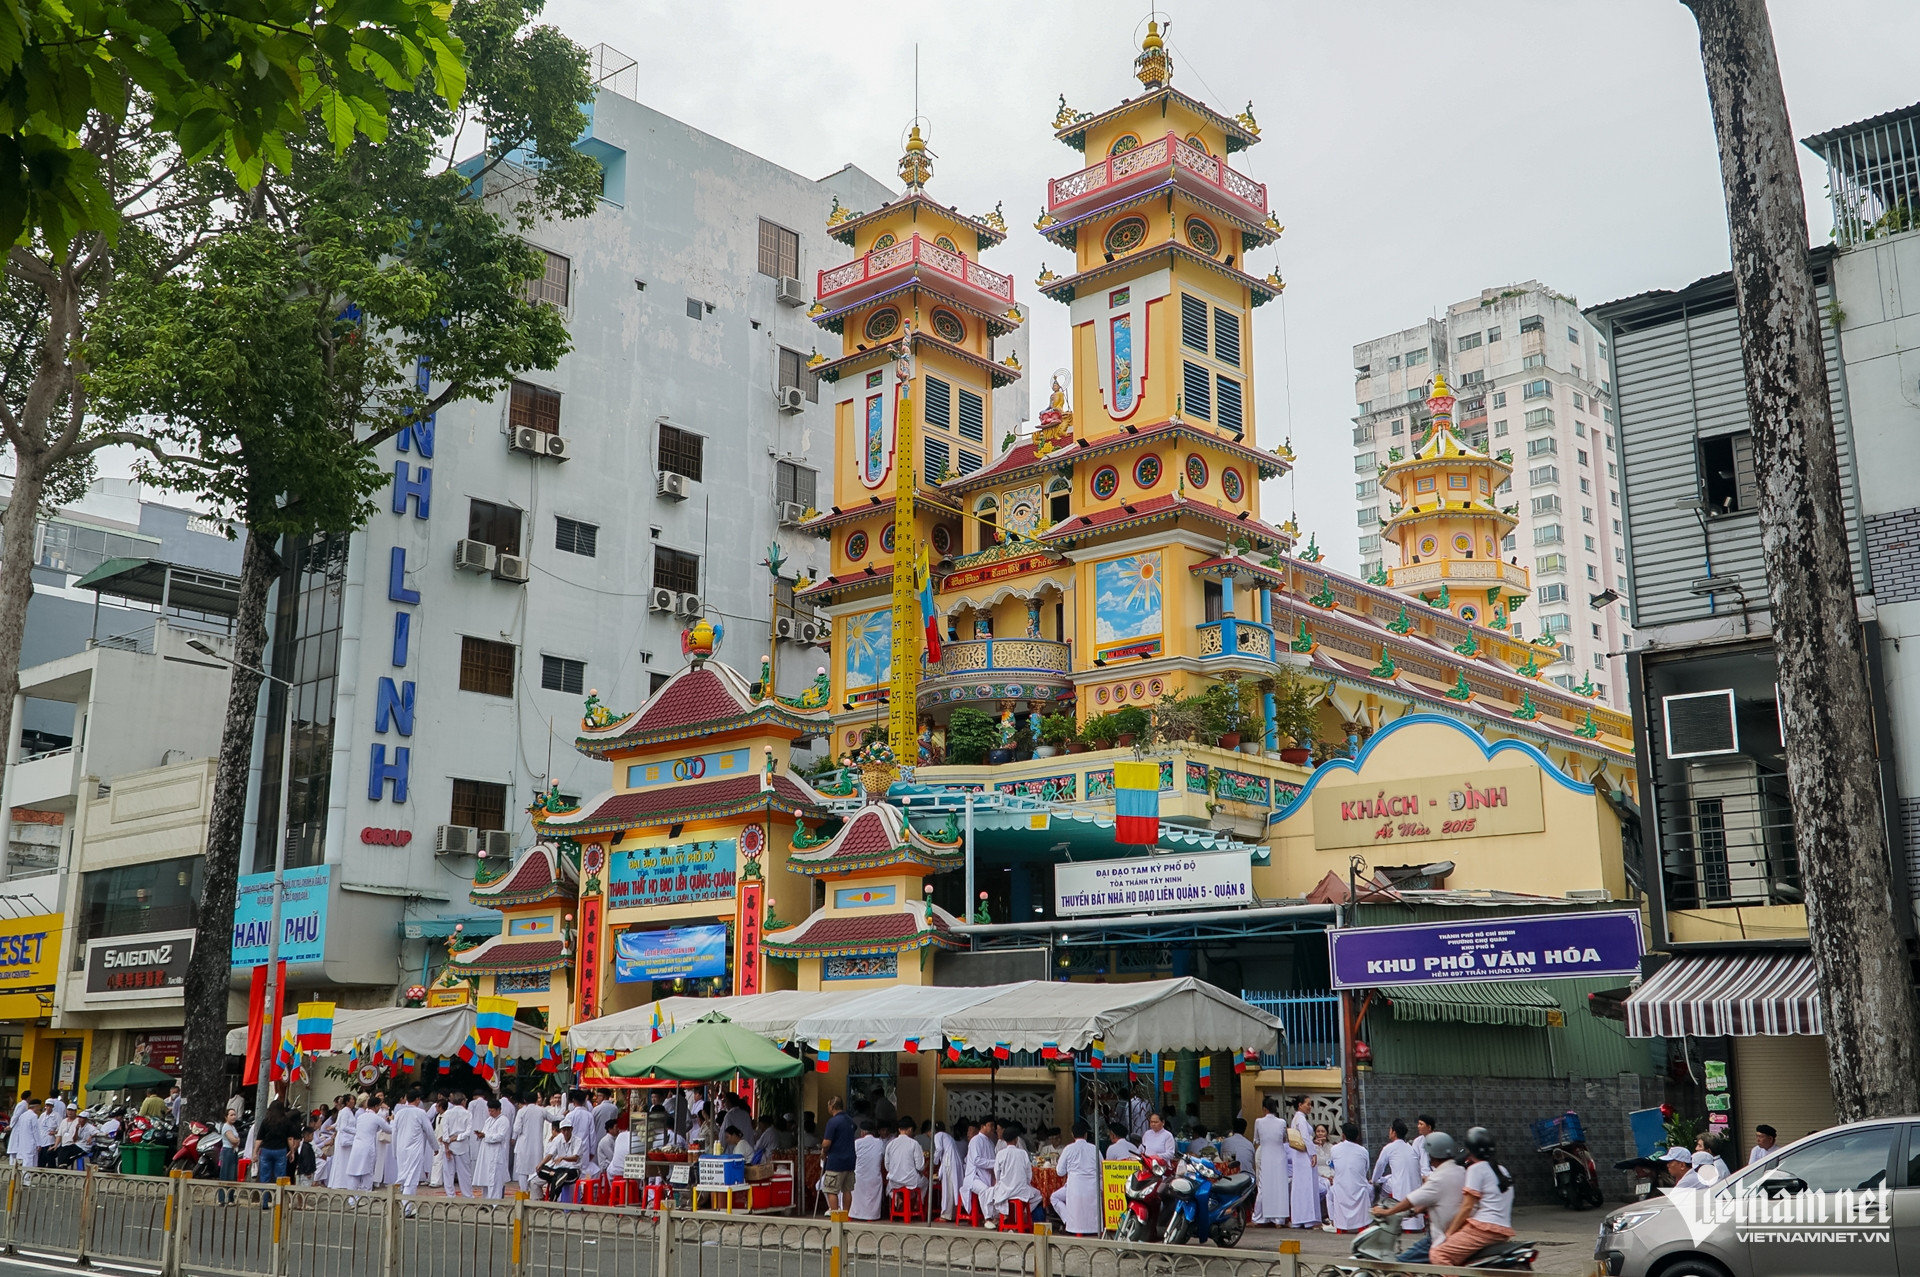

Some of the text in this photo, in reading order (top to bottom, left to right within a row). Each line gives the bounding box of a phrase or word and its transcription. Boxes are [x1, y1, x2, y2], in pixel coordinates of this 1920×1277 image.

[367, 546, 421, 803] LINH
[1341, 791, 1419, 821] KHÁCH
[1449, 782, 1508, 811] ĐÌNH
[361, 826, 412, 847] GROUP
[1441, 818, 1476, 834] 2015
[1096, 869, 1109, 879] ĐẠI
[1112, 868, 1129, 878] ĐẠO
[1131, 866, 1148, 875] TAM
[1184, 860, 1196, 872] ĐỘ
[1110, 879, 1124, 887] TÒA
[1126, 878, 1148, 886] THÁNH
[1150, 876, 1163, 885] TÂY
[1091, 890, 1105, 905] BÁT
[1126, 891, 1137, 906] HỌ
[1139, 889, 1155, 905] ĐẠO
[1156, 885, 1174, 901] LIÊN
[1176, 883, 1199, 902] QUẬN
[1201, 886, 1206, 898] 5
[1214, 880, 1237, 899] QUẬN
[1240, 883, 1245, 895] 8
[1367, 946, 1602, 974] KHU PHỐ VĂN HÓA
[1108, 1184, 1119, 1193] VUI
